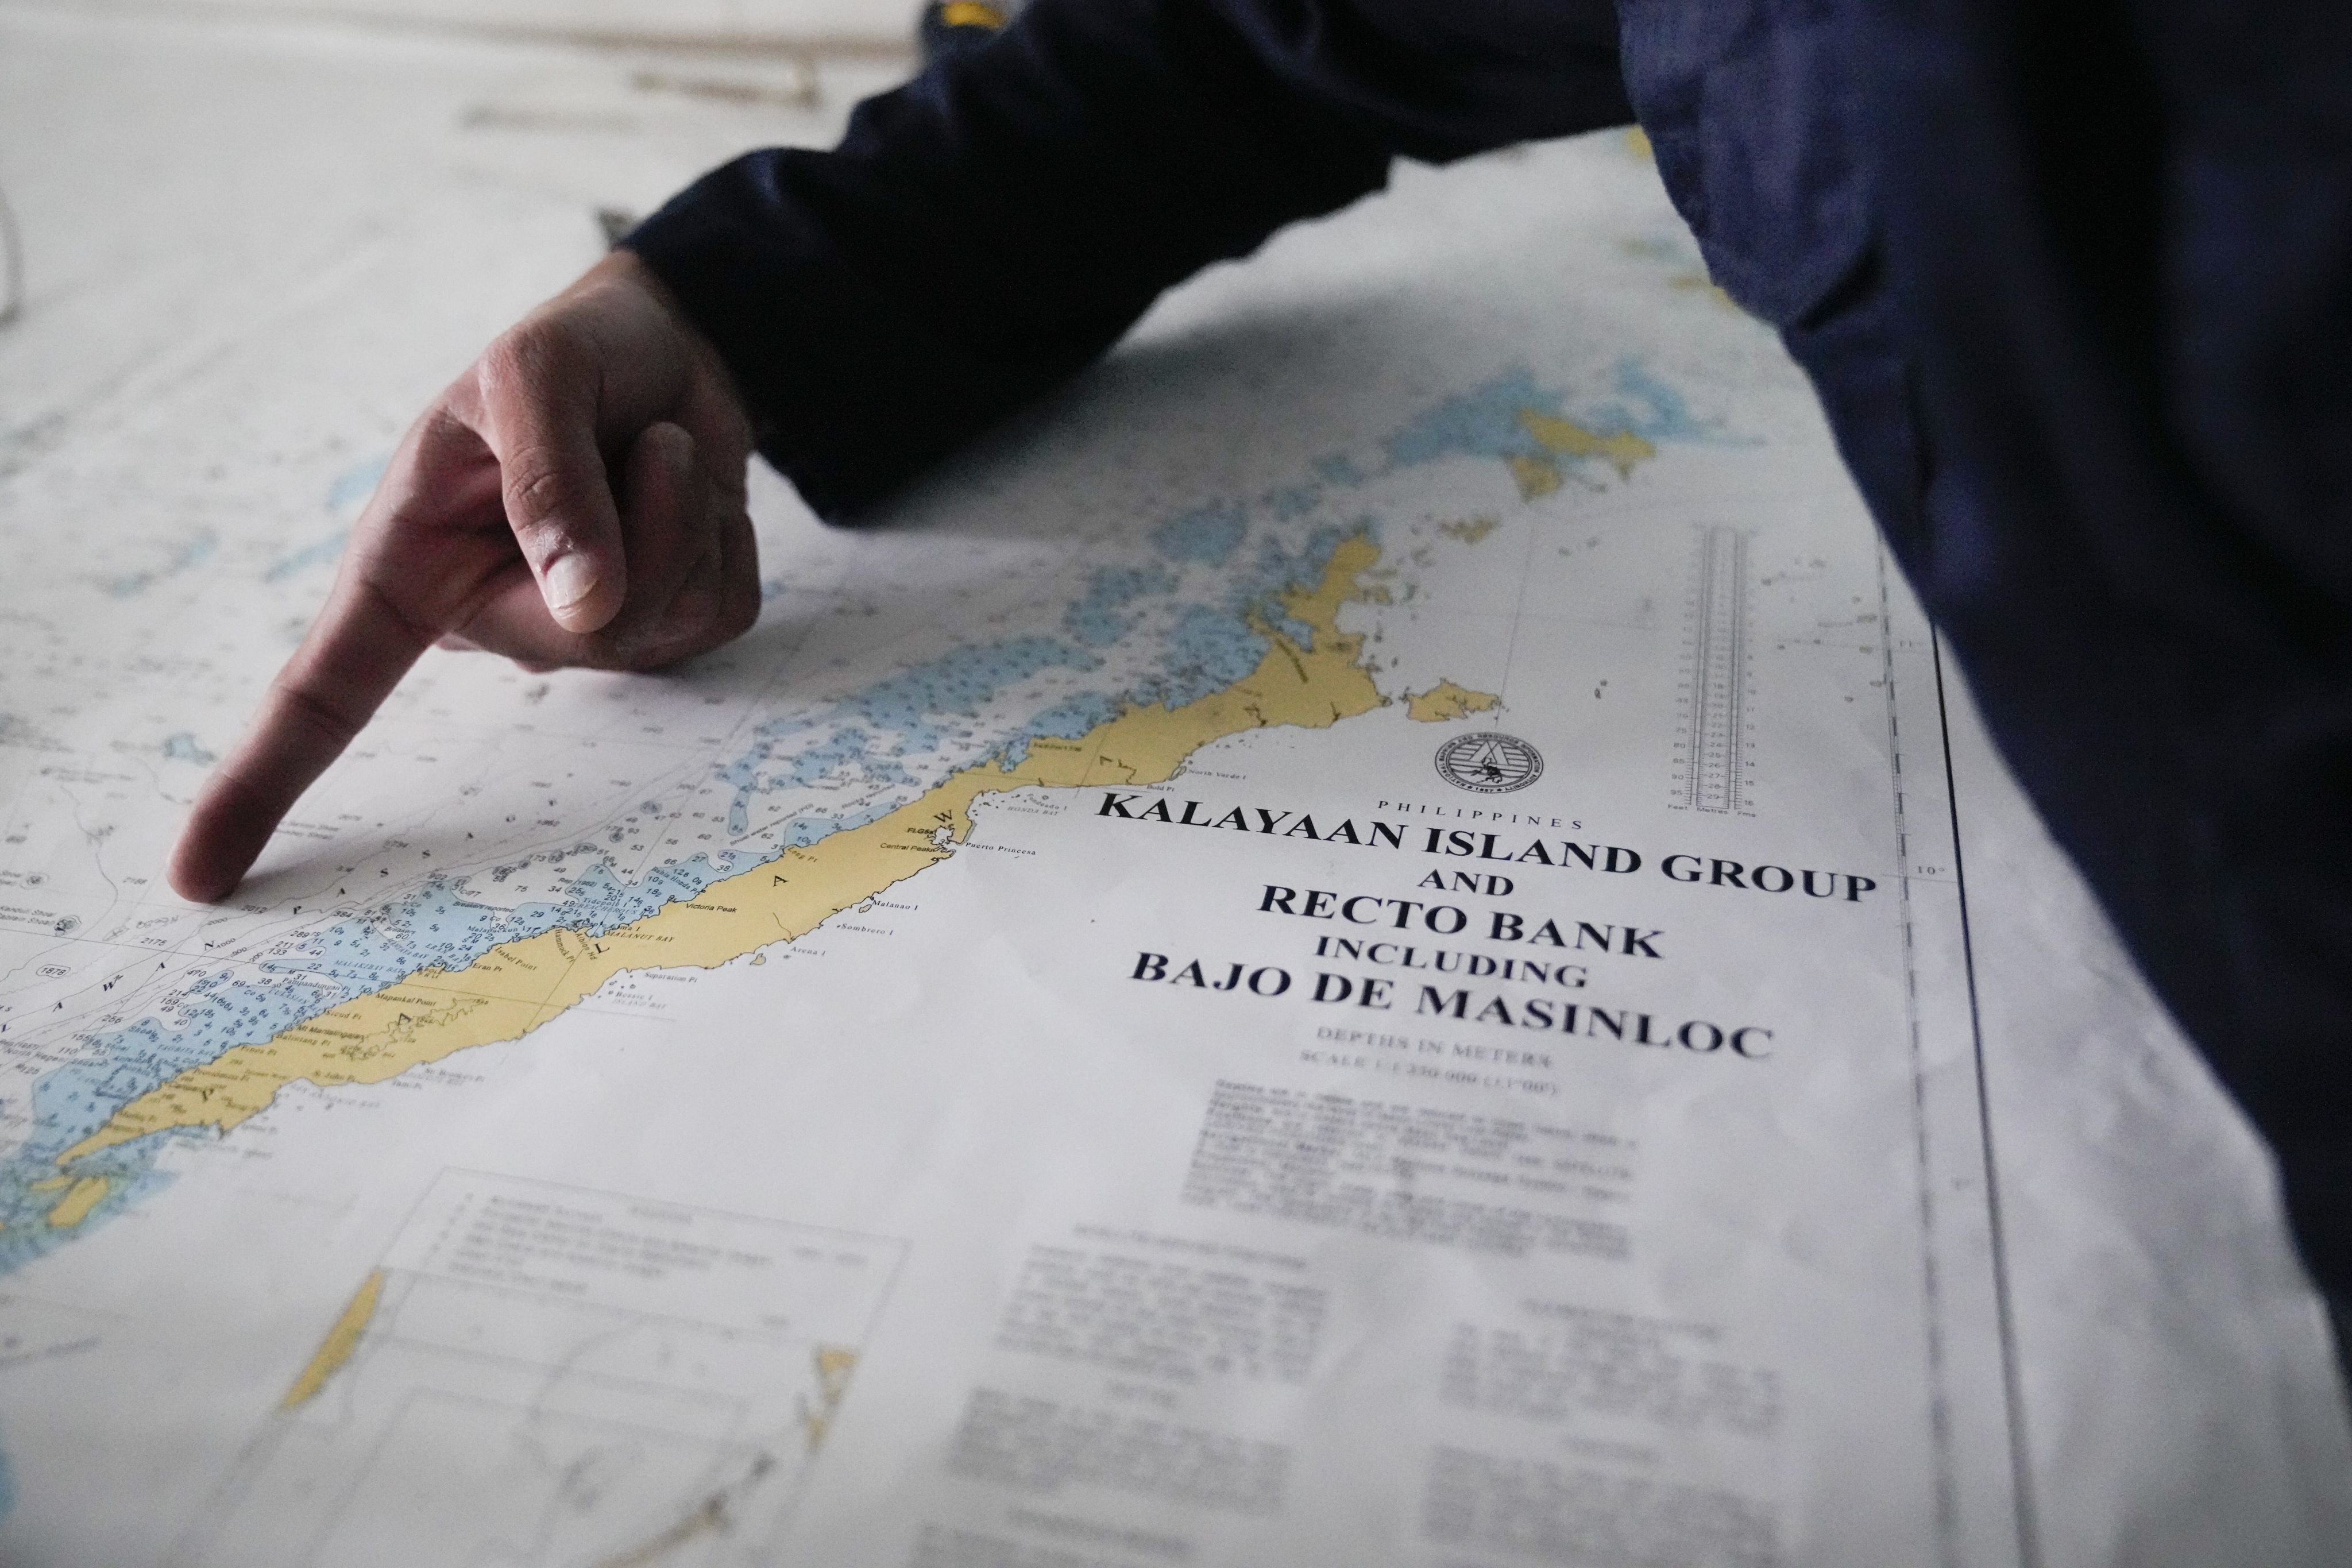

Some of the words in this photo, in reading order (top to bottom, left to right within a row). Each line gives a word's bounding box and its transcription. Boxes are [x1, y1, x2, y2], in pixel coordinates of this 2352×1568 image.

[1007, 806, 1040, 814] HONDA
[1696, 806, 1729, 815] Metres
[1737, 810, 1756, 818] Fms
[933, 809, 953, 823] W
[1378, 801, 1583, 831] PHILIPPINES
[880, 842, 910, 851] Central
[965, 841, 995, 851] Puerto
[997, 845, 1037, 856] Princesa
[1095, 792, 1409, 849] KALAYAAN
[1421, 828, 1642, 874] ISLAND
[1660, 854, 1876, 902] GROUP
[787, 847, 805, 860] Long
[663, 858, 678, 866] 66
[717, 864, 731, 872] 38
[1917, 865, 1946, 876] 10°
[773, 874, 789, 887] A
[1417, 868, 1515, 897] AND
[241, 904, 268, 914] 2012
[486, 904, 515, 913] reported
[686, 902, 715, 912] Victoria
[716, 905, 739, 913] Peak
[871, 899, 912, 910] Malanao
[530, 910, 545, 918] 29
[1256, 885, 1467, 934] RECTO
[1488, 910, 1665, 959] BANK
[840, 923, 886, 935] Sombrero
[606, 930, 654, 941] MALANUT
[140, 937, 168, 946] 2175
[216, 937, 236, 949] 1000
[275, 940, 295, 949] 211
[231, 947, 248, 957] 500
[267, 948, 288, 956] 133
[458, 944, 473, 952] 24
[594, 943, 611, 954] L
[790, 946, 818, 956] Arena
[249, 952, 264, 963] 200
[495, 946, 517, 962] Isabel
[516, 959, 538, 971] Point
[1314, 935, 1588, 989] INCLUDING
[40, 967, 67, 976] 1878
[472, 963, 492, 971] Eran
[168, 989, 189, 997] 214
[415, 998, 438, 1006] Point
[1128, 952, 1292, 997] BAJO
[1311, 972, 1395, 1010] DE
[1416, 985, 1775, 1060] MASINLOC
[102, 1014, 124, 1024] 256
[1316, 1026, 1410, 1050] DEPTHS
[1418, 1038, 1444, 1055] IN
[1299, 1049, 1365, 1068] SCALE
